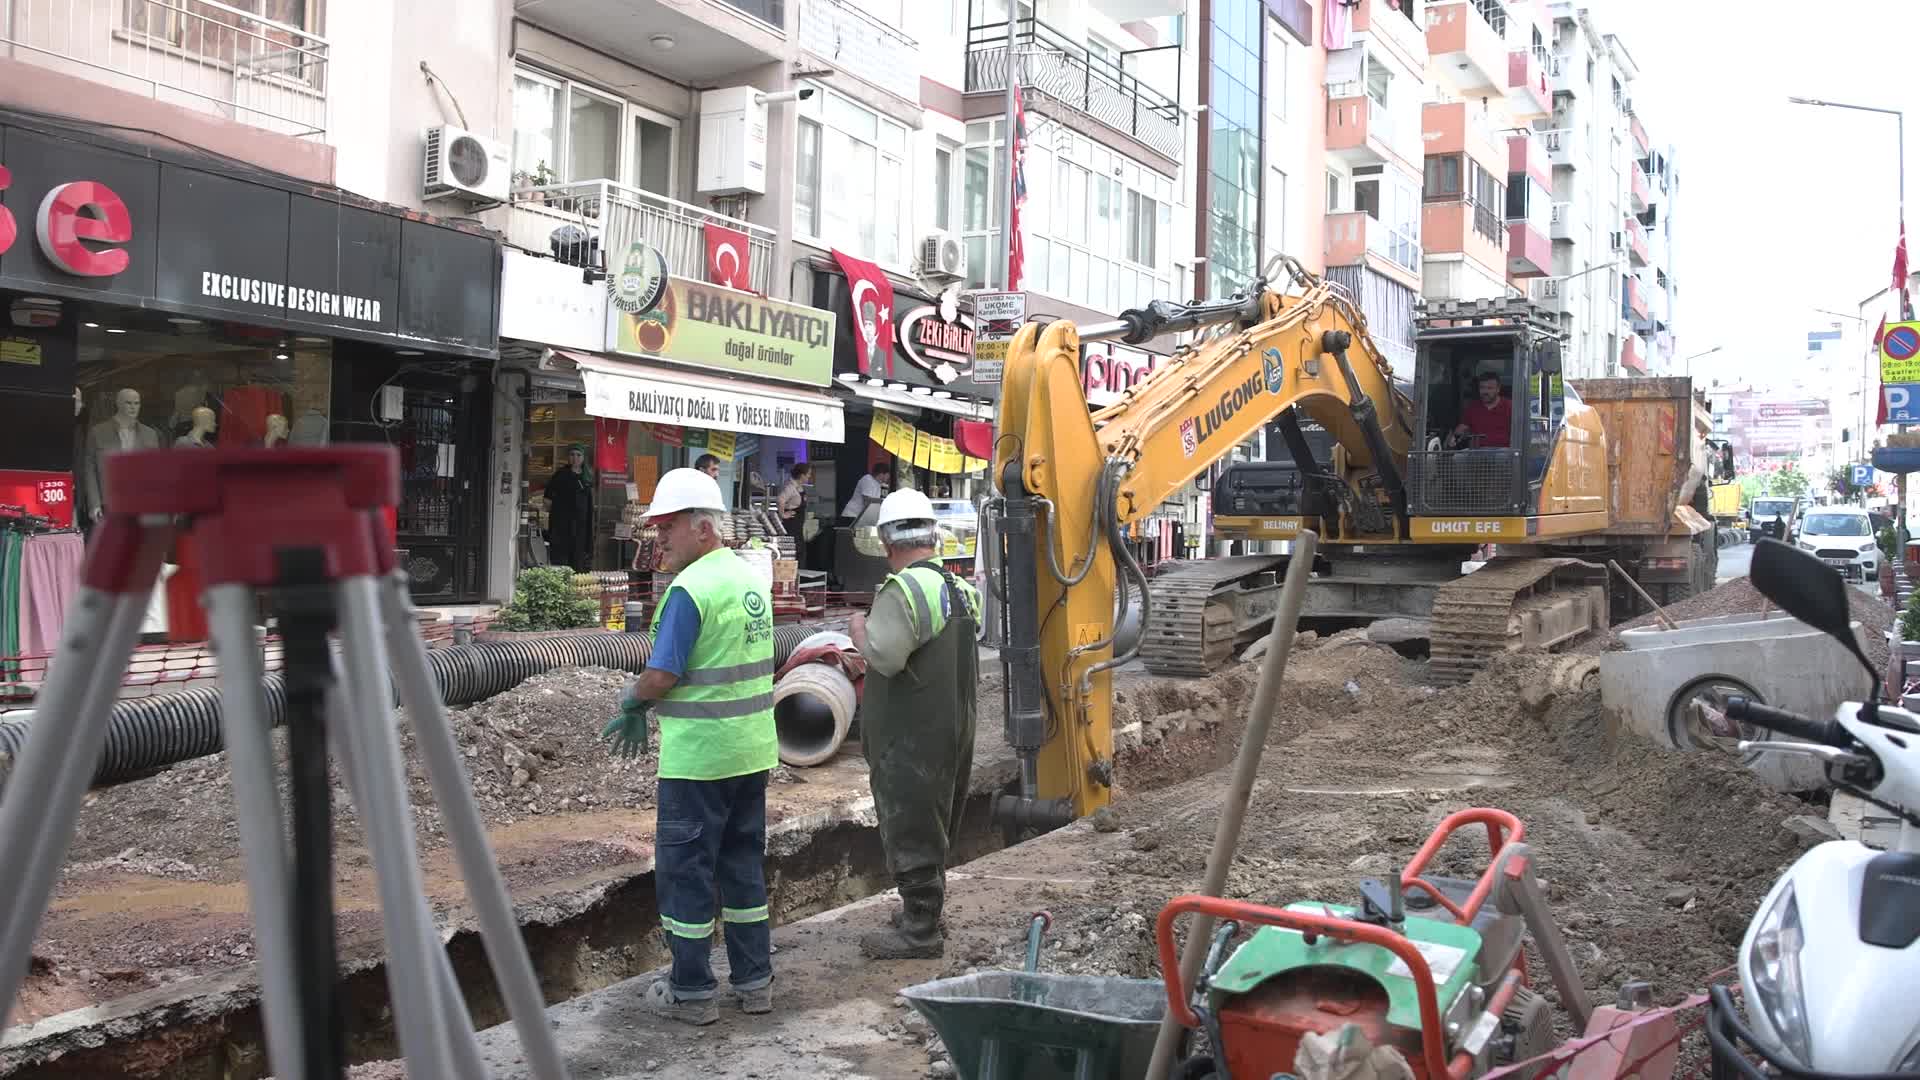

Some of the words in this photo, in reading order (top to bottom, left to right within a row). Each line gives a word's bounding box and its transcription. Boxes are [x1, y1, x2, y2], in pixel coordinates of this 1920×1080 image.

[202, 271, 285, 308] EXCLUSIVE
[288, 286, 340, 316] DESIGN
[343, 295, 381, 322] WEAR
[613, 295, 638, 312] YÖRESEL
[724, 338, 755, 362] doğal
[757, 344, 795, 367] ürünler
[628, 390, 684, 422] BAKLİYATÇI
[687, 397, 715, 421] DOĞAL
[718, 404, 729, 423] VE
[735, 404, 772, 428] YÖRESEL
[774, 406, 810, 432] ÜRÜNLER
[1884, 387, 1910, 420] P
[1854, 468, 1868, 484] P
[1431, 521, 1470, 533] UMUT
[1475, 521, 1501, 533] EFE
